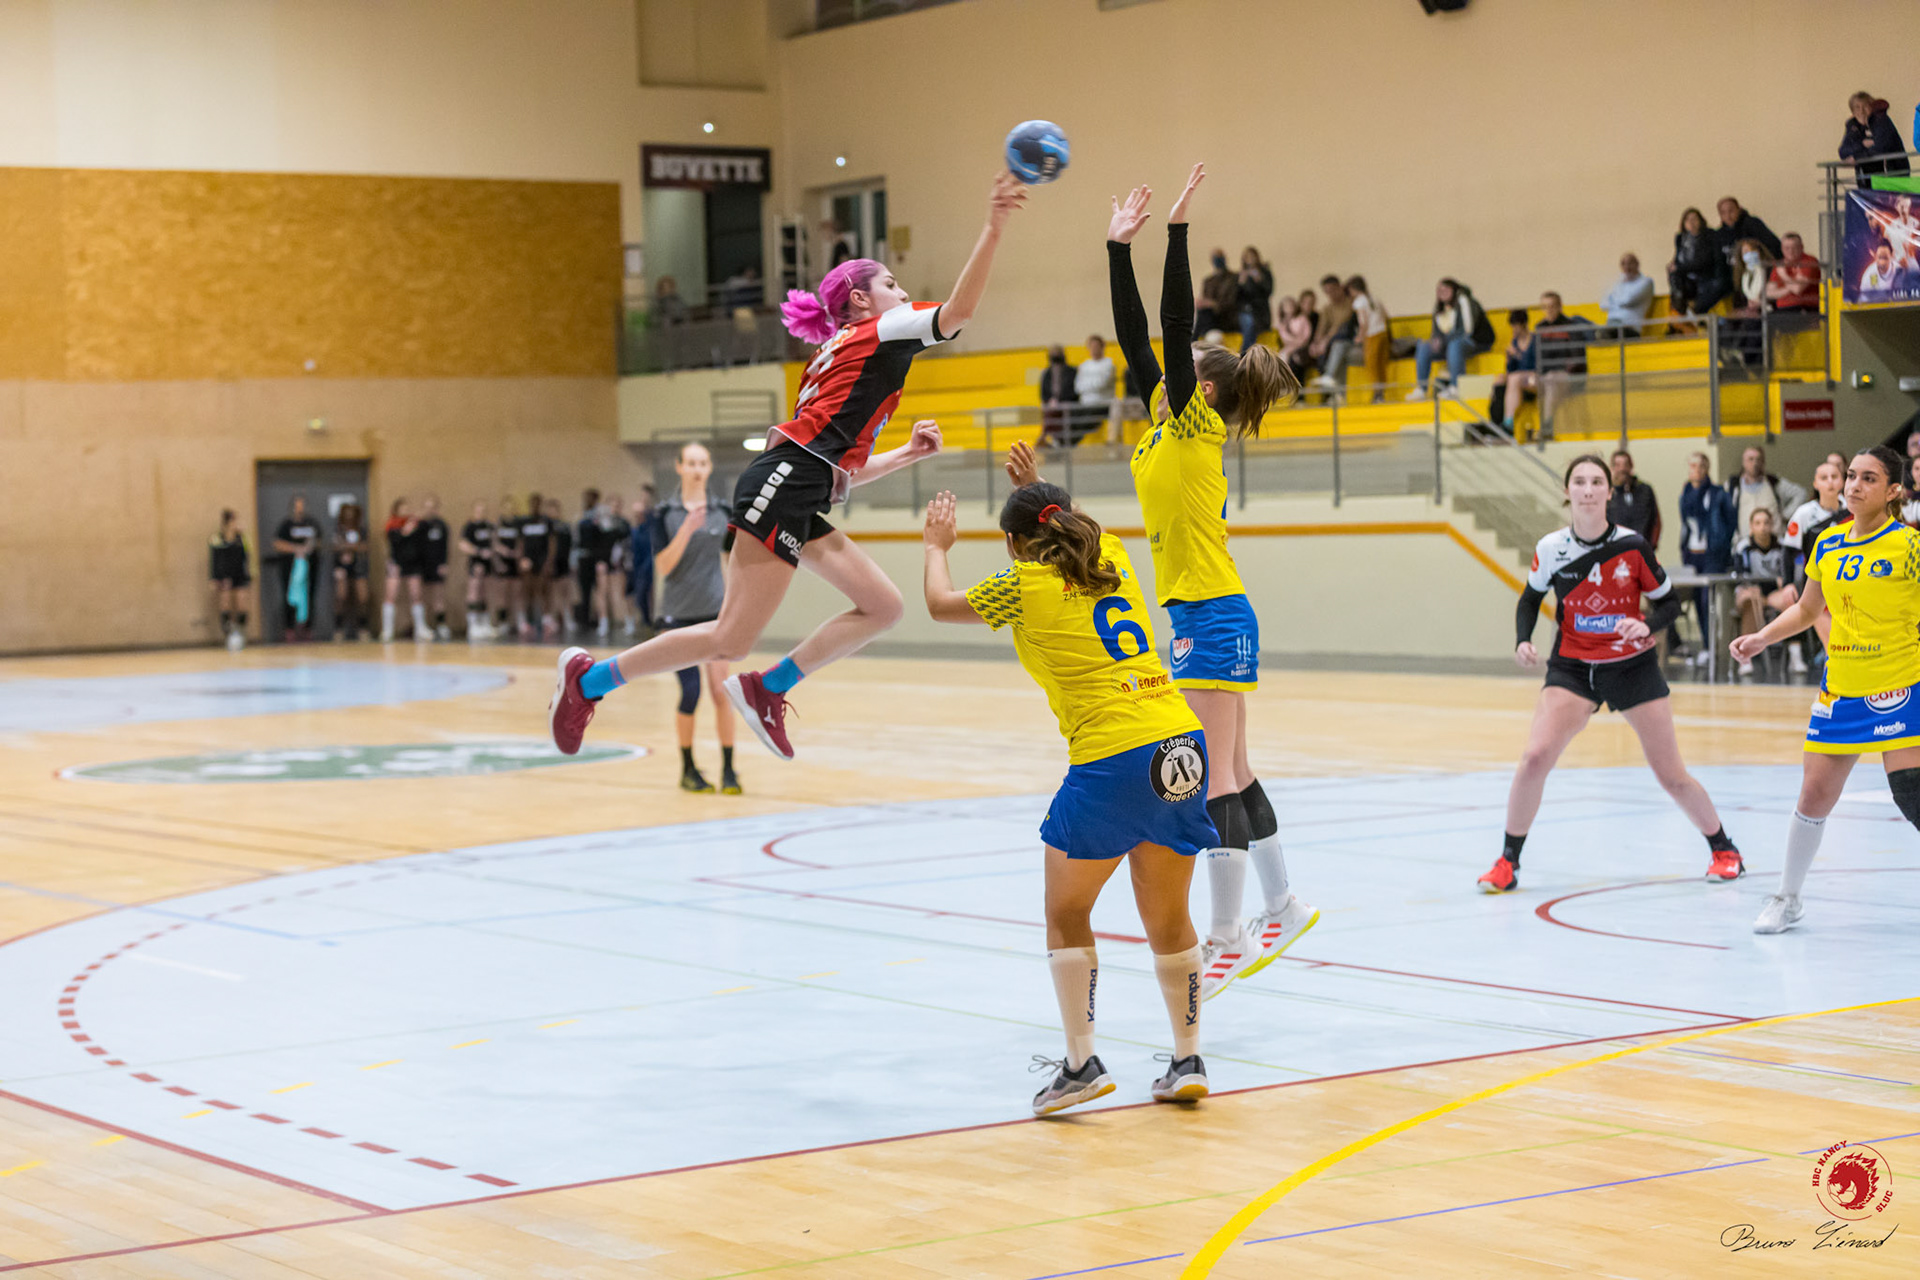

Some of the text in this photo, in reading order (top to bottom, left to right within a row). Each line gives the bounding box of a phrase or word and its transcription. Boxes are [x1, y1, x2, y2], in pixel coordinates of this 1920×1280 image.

[650, 154, 762, 182] BUVETTE
[1588, 562, 1603, 586] 4
[1836, 554, 1864, 581] 13
[1093, 596, 1149, 661] 6
[1869, 688, 1906, 703] cora
[1873, 721, 1907, 736] Moselle
[1160, 736, 1195, 754] Crêperie
[1163, 783, 1202, 802] moderne
[1087, 968, 1098, 1023] Kempa
[1186, 972, 1200, 1026] Kempa
